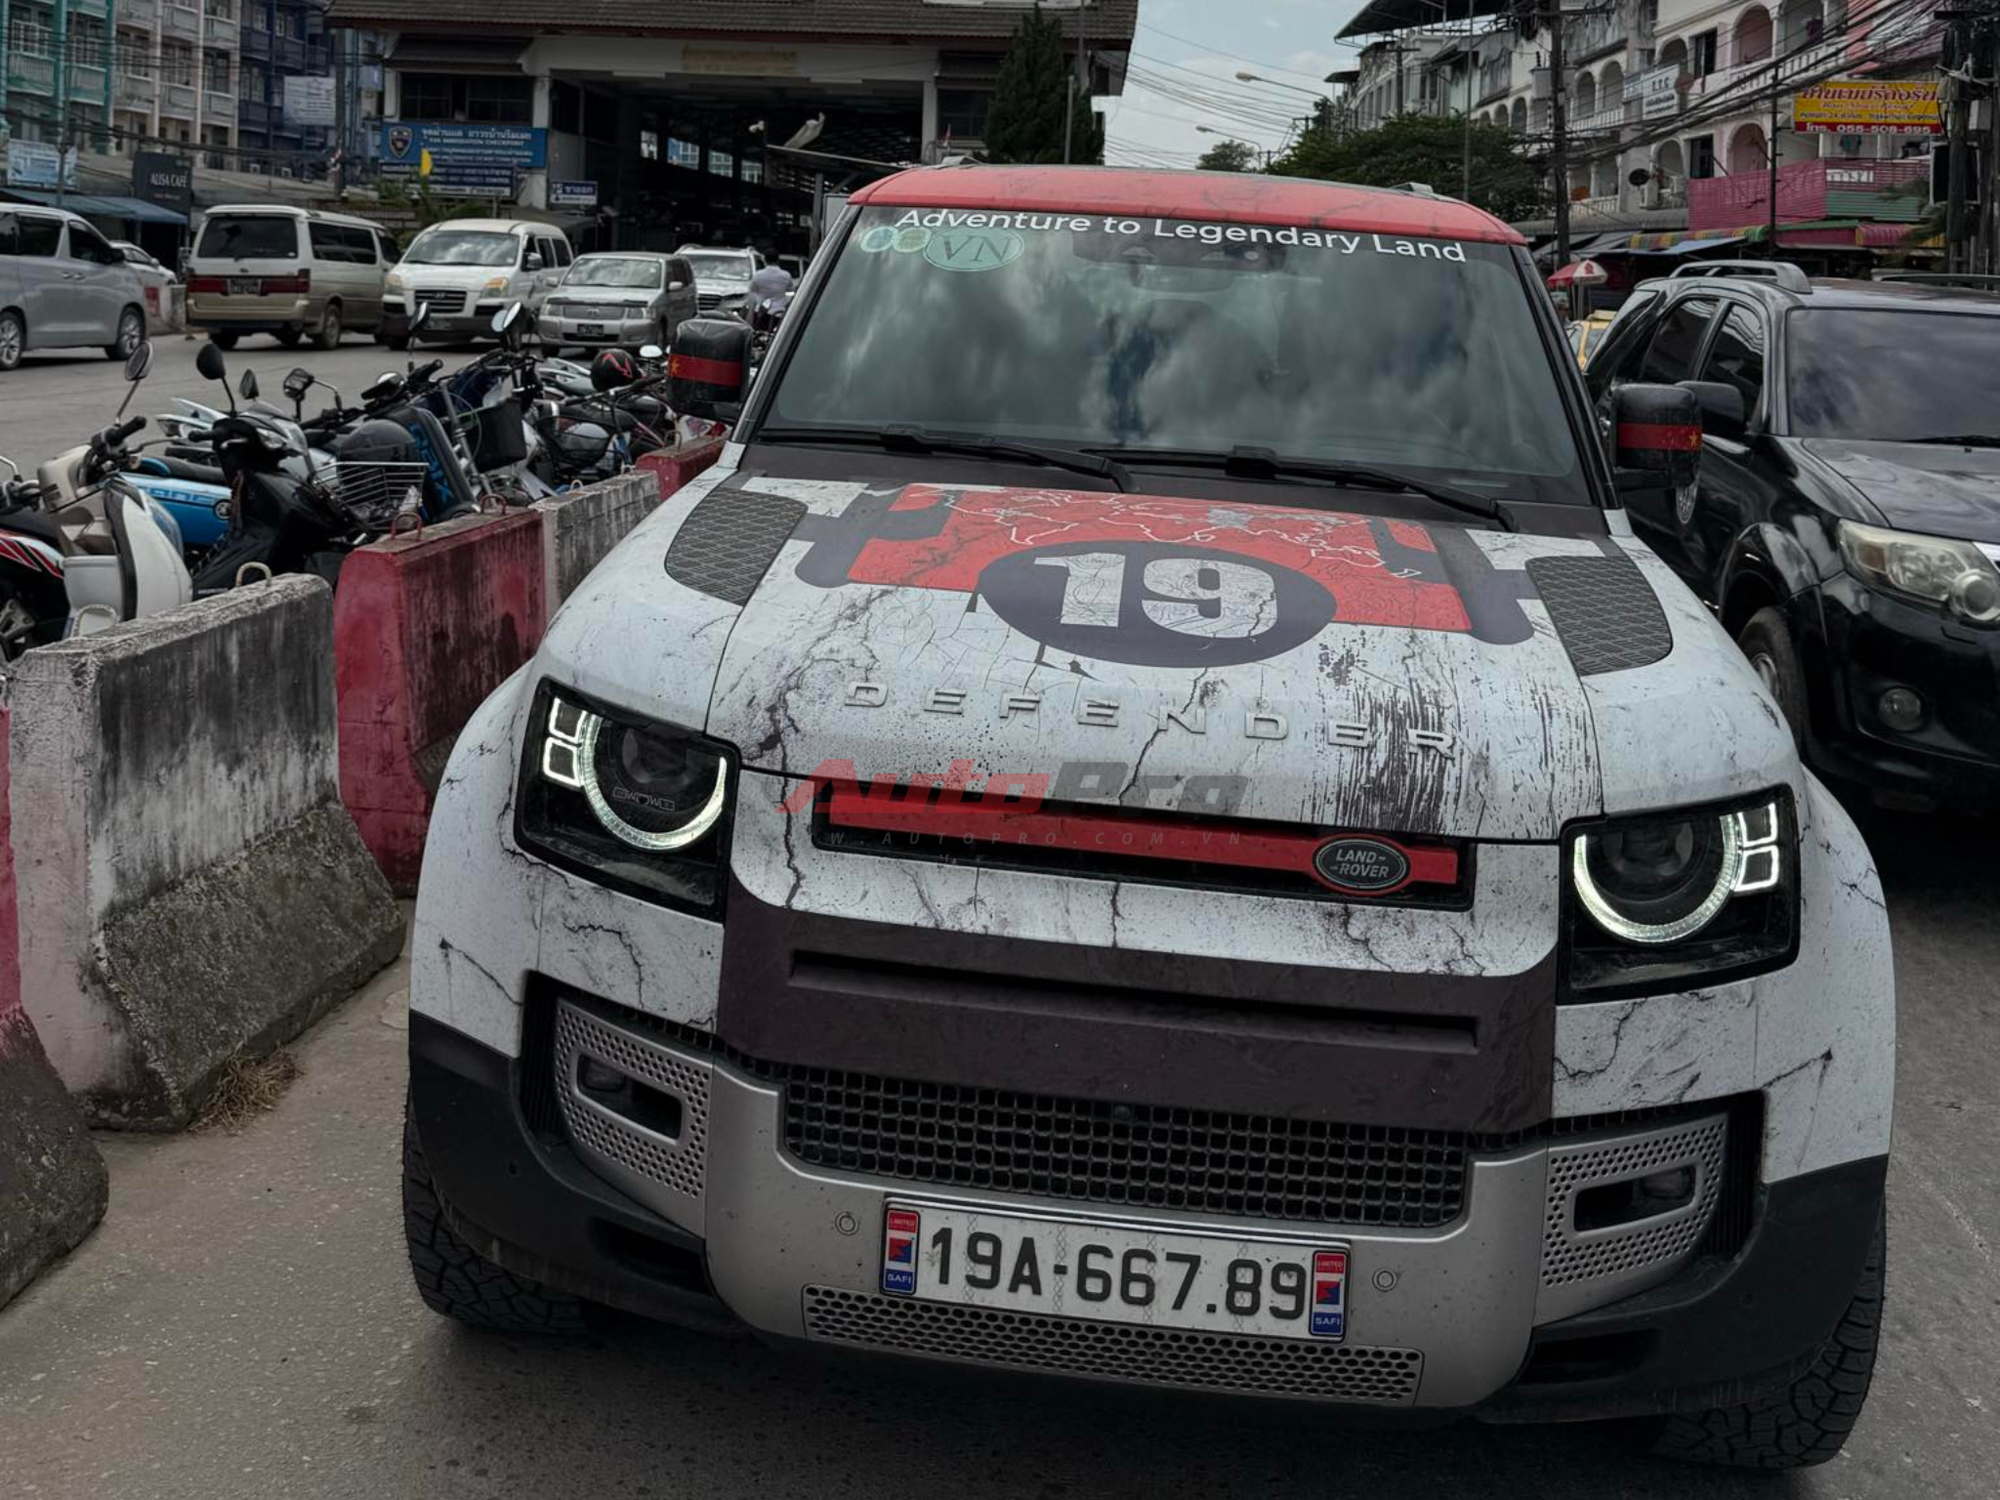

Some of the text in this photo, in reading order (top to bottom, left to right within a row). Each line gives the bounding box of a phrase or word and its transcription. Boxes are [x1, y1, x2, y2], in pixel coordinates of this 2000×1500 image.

[894, 209, 1467, 262] Adventure to Legendary Land
[939, 234, 1016, 262] VN
[1034, 552, 1278, 638] 19
[844, 681, 1457, 761] DEFENDER
[931, 1227, 1306, 1320] 19A-667.89
